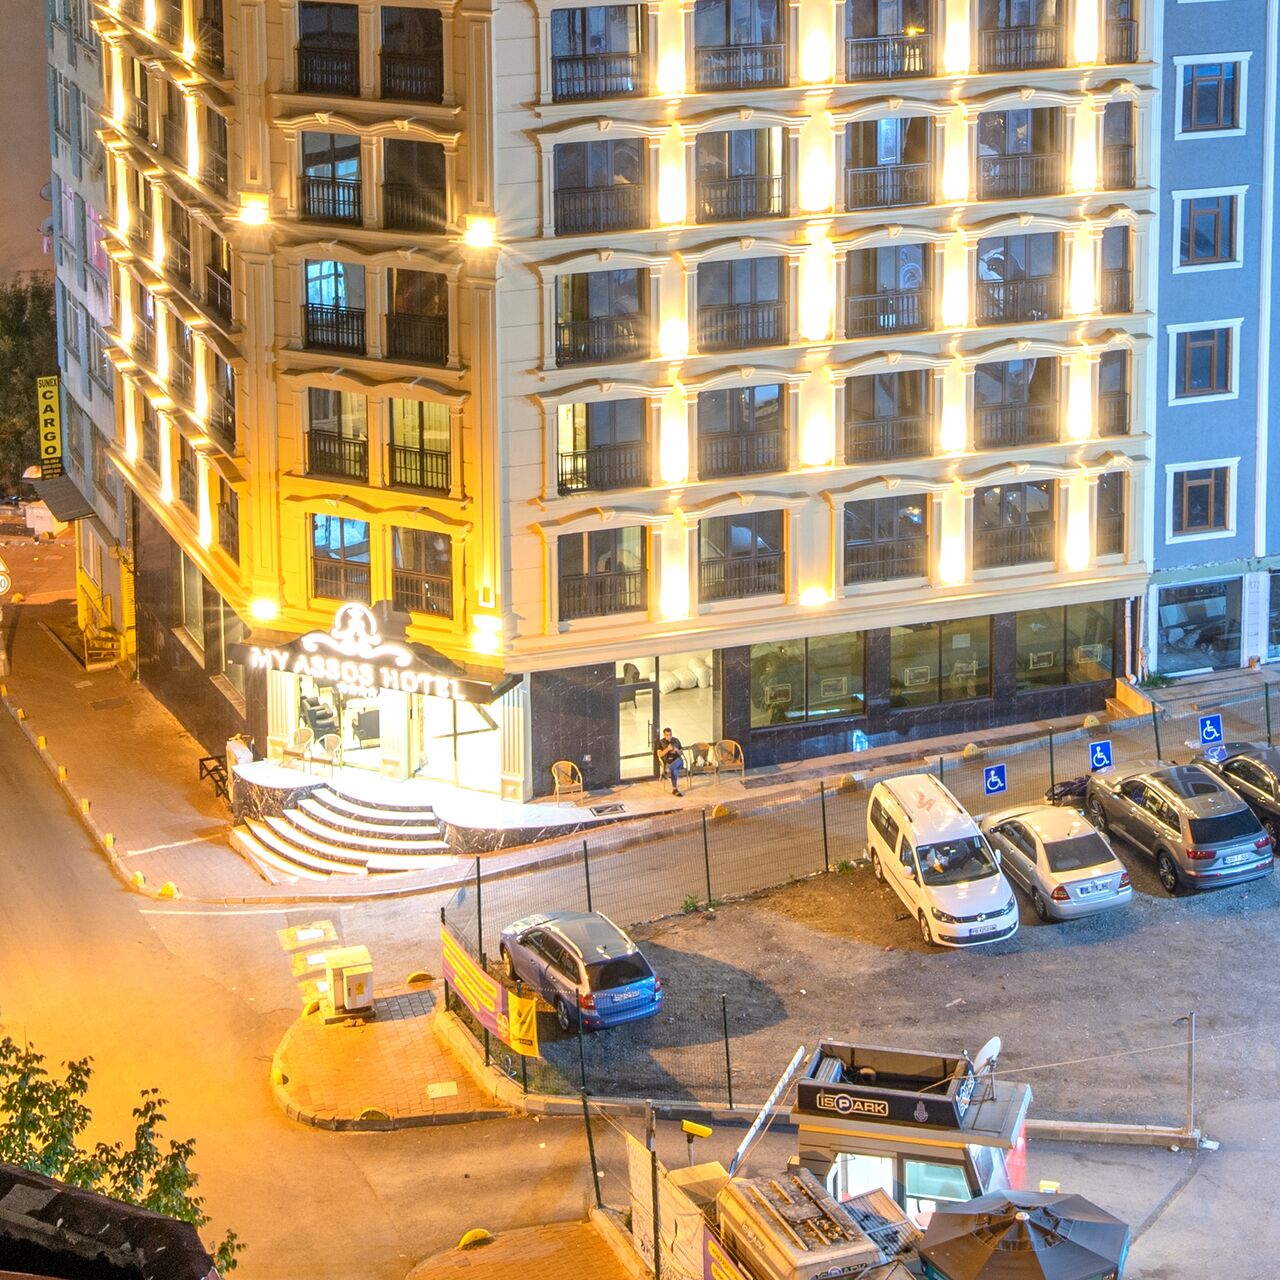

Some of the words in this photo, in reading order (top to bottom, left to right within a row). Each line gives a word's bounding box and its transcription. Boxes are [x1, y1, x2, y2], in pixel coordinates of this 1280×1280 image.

[42, 390, 56, 455] CARGO
[250, 646, 289, 671] MY
[293, 654, 375, 684] ASSOS
[379, 666, 466, 701] HOTEL
